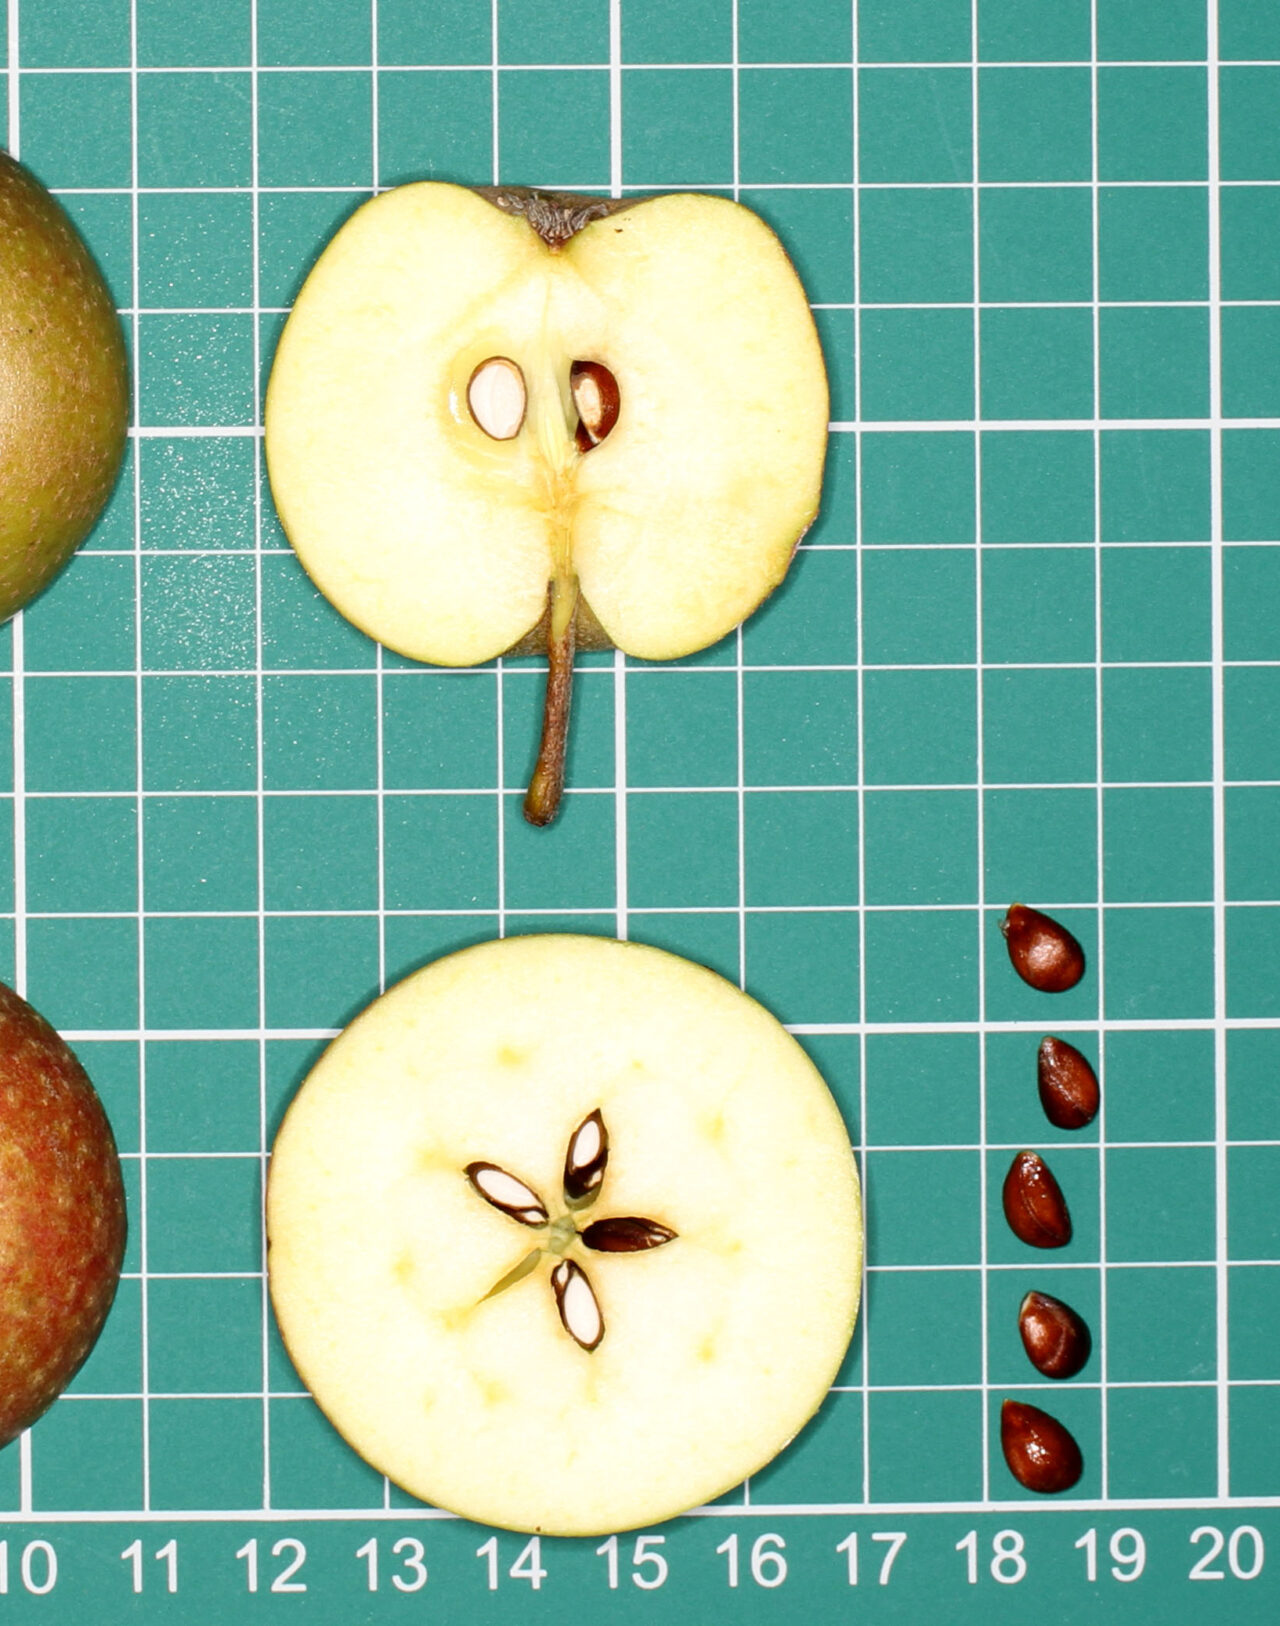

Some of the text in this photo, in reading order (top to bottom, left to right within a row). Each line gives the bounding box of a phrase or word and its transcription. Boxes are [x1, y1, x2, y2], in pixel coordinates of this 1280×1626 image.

[119, 1538, 179, 1595] 11
[234, 1537, 308, 1594] 12
[355, 1536, 430, 1593] 13
[474, 1535, 549, 1592] 14
[595, 1534, 670, 1591] 15
[715, 1532, 790, 1589] 16
[835, 1530, 909, 1587] 17
[954, 1528, 1028, 1585] 18
[1074, 1526, 1147, 1583] 19
[1187, 1524, 1265, 1581] 20
